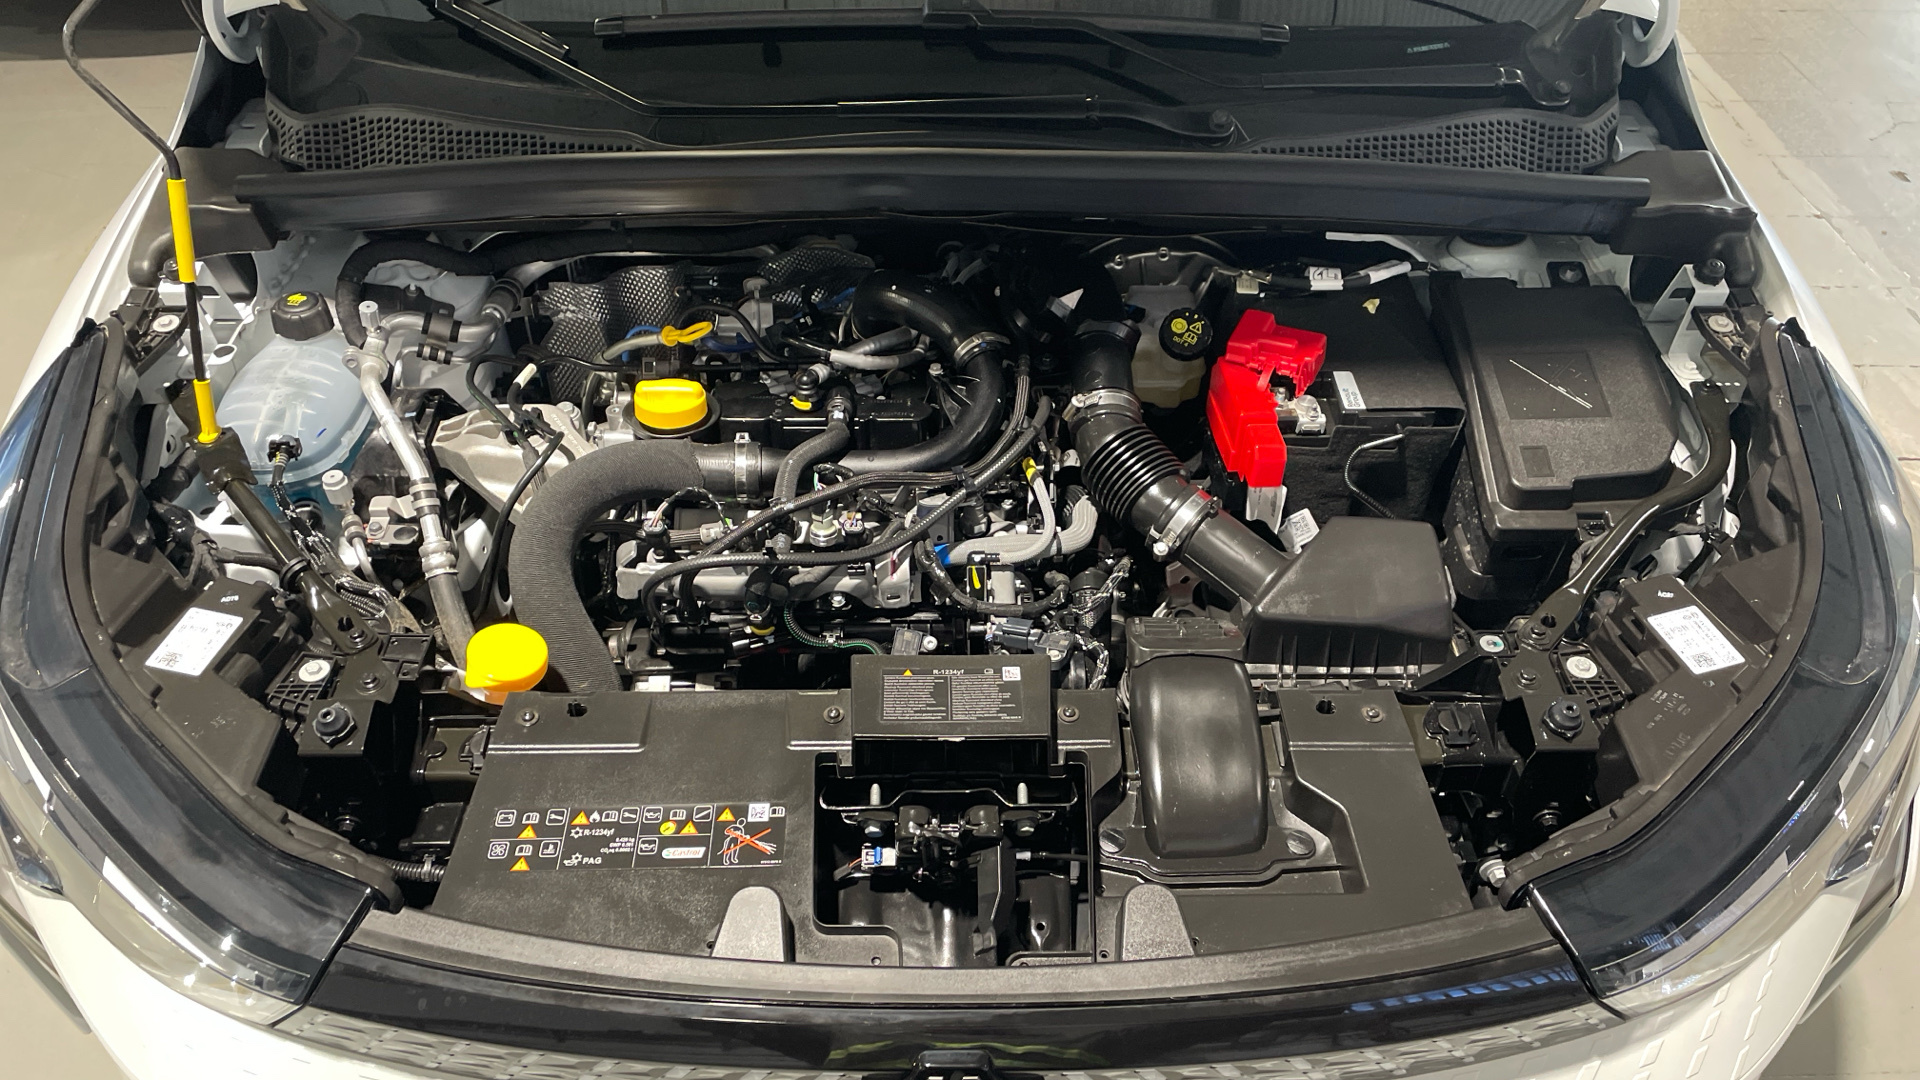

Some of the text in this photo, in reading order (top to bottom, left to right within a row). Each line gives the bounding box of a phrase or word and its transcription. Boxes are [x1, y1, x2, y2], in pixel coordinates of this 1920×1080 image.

[583, 828, 615, 837] R-1234yf
[672, 849, 701, 857] Castrol
[582, 856, 602, 865] PAG
